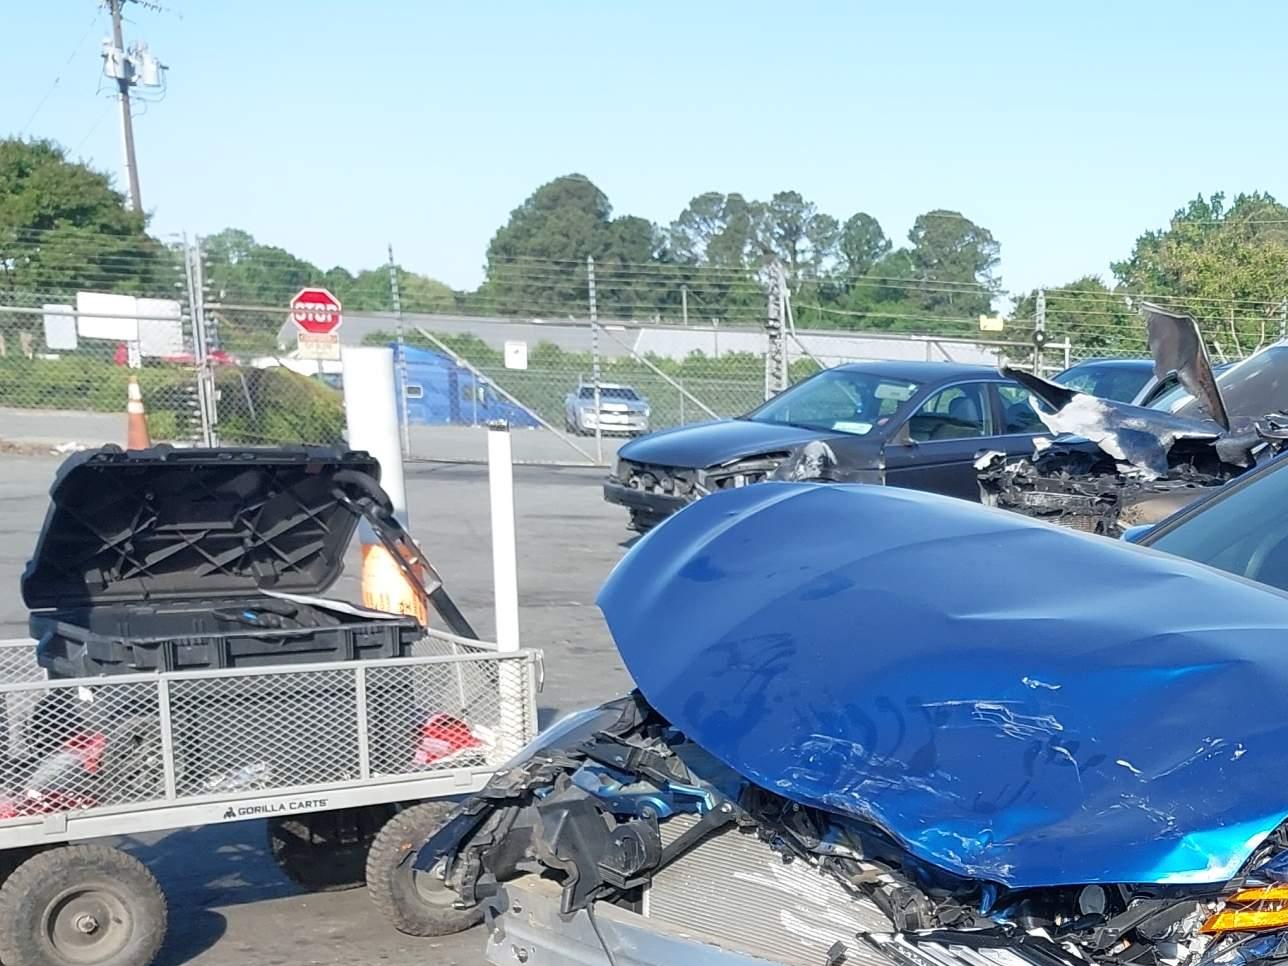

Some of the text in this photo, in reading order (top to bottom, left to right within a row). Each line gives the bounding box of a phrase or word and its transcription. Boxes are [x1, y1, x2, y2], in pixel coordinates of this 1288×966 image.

[295, 302, 337, 322] STOP
[238, 800, 326, 816] GORILLA CARTS
